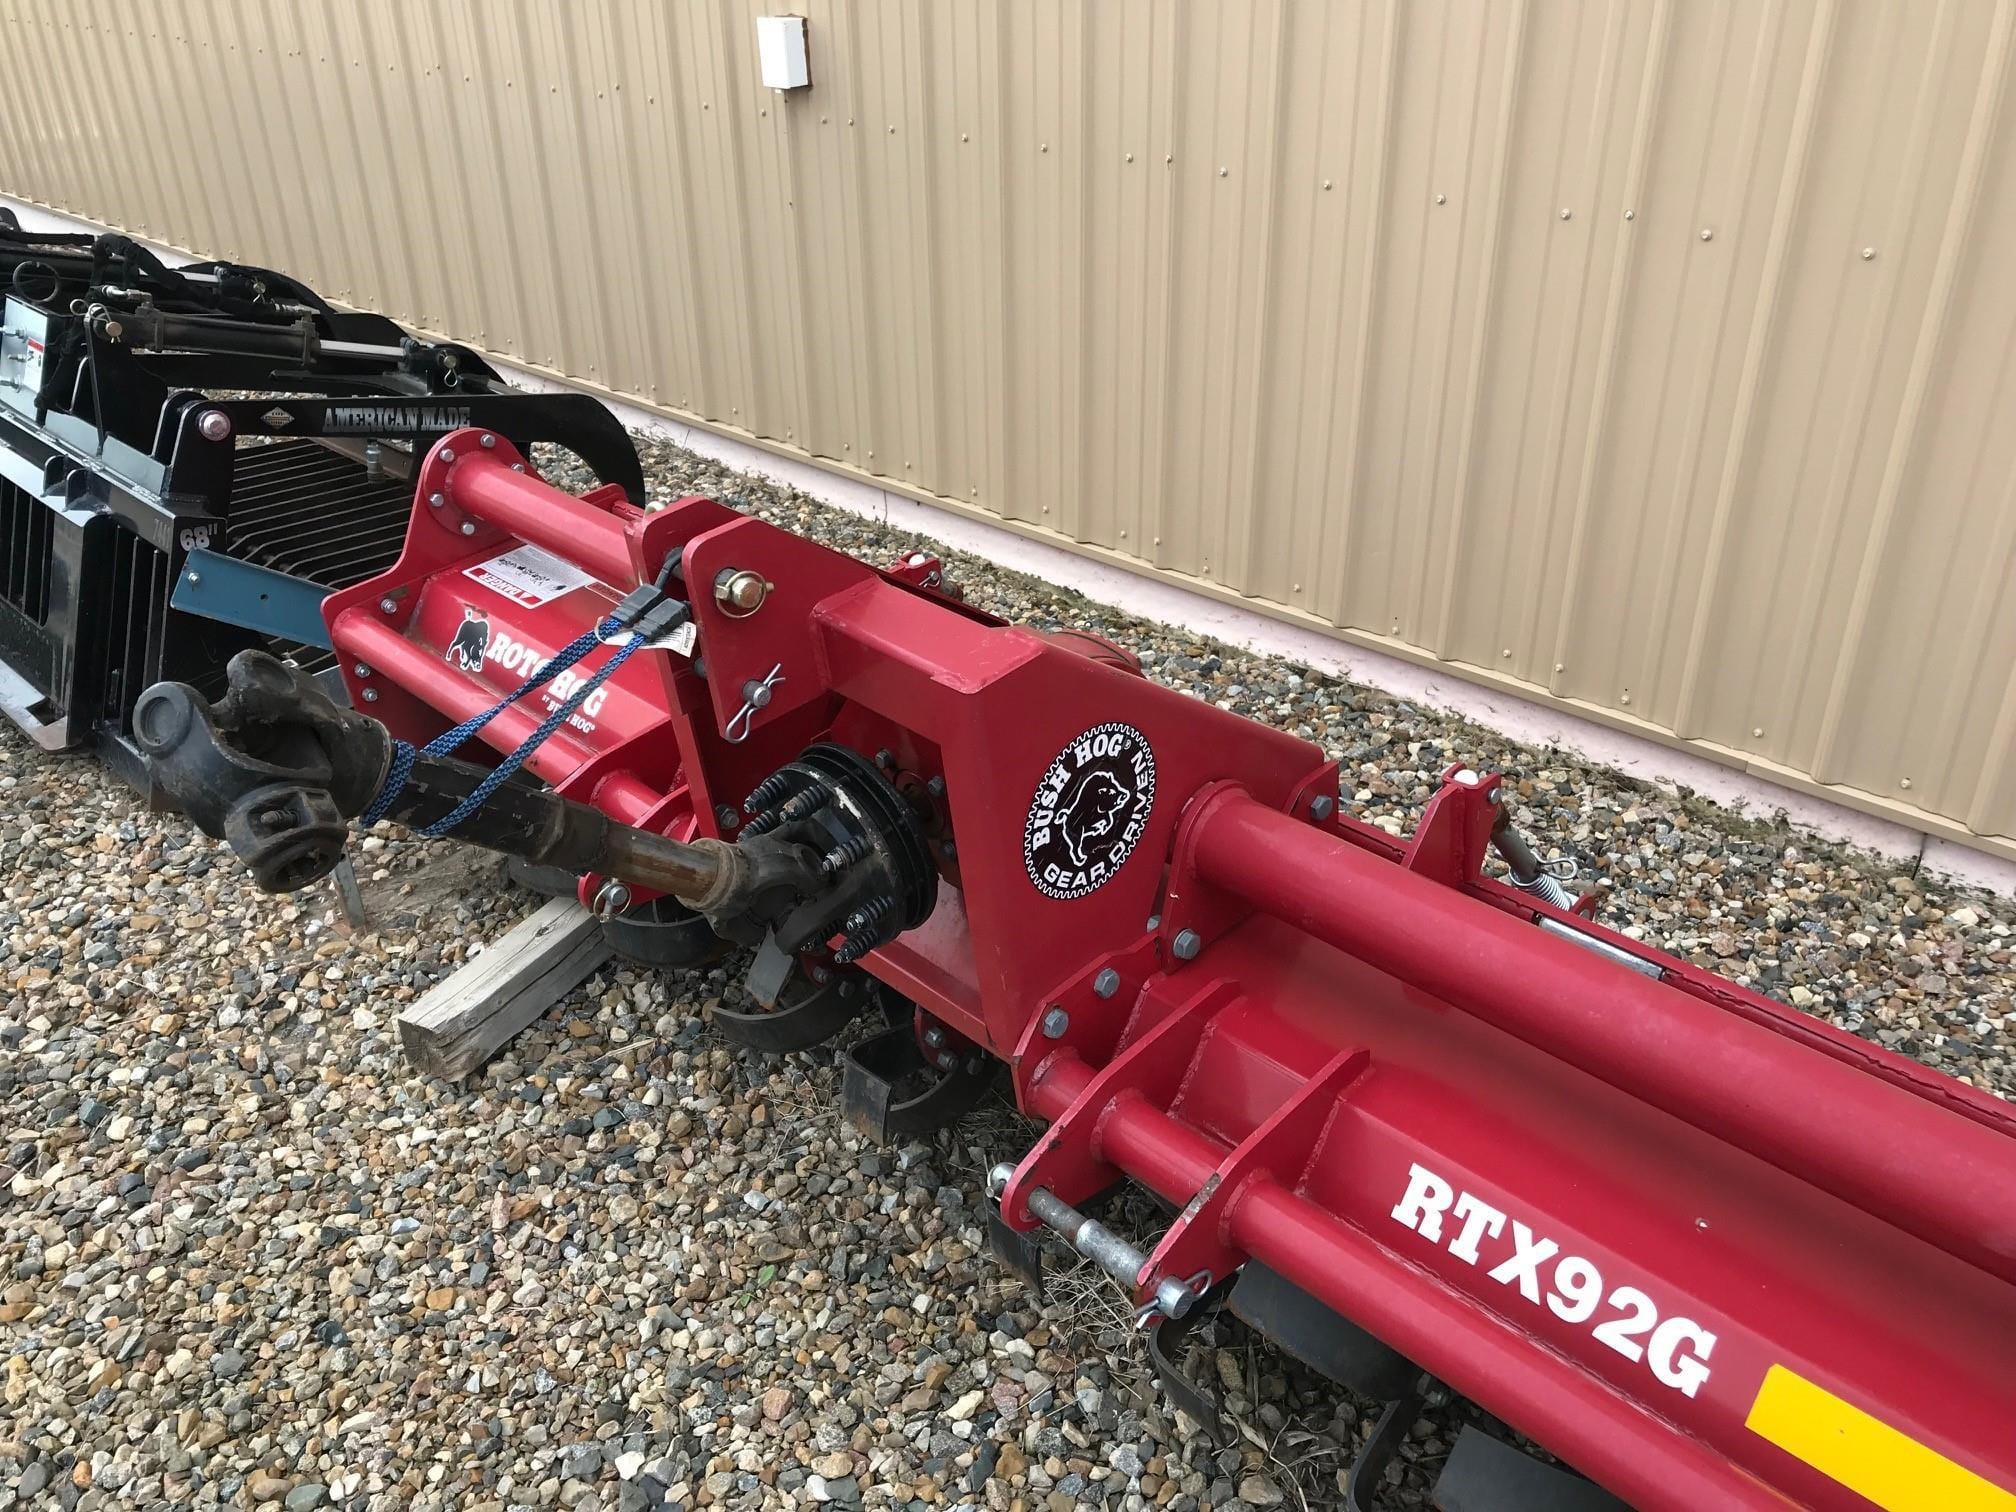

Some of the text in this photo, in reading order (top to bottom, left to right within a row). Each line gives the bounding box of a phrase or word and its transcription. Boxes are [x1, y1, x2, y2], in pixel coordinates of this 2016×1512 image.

[323, 407, 417, 432] AMERICAN
[421, 406, 471, 431] MADE
[479, 572, 519, 596] DANGER
[1032, 763, 1072, 851] BUSH
[1043, 751, 1149, 889] GEAR DRIVEN
[1390, 1162, 1717, 1399] RTX92G
